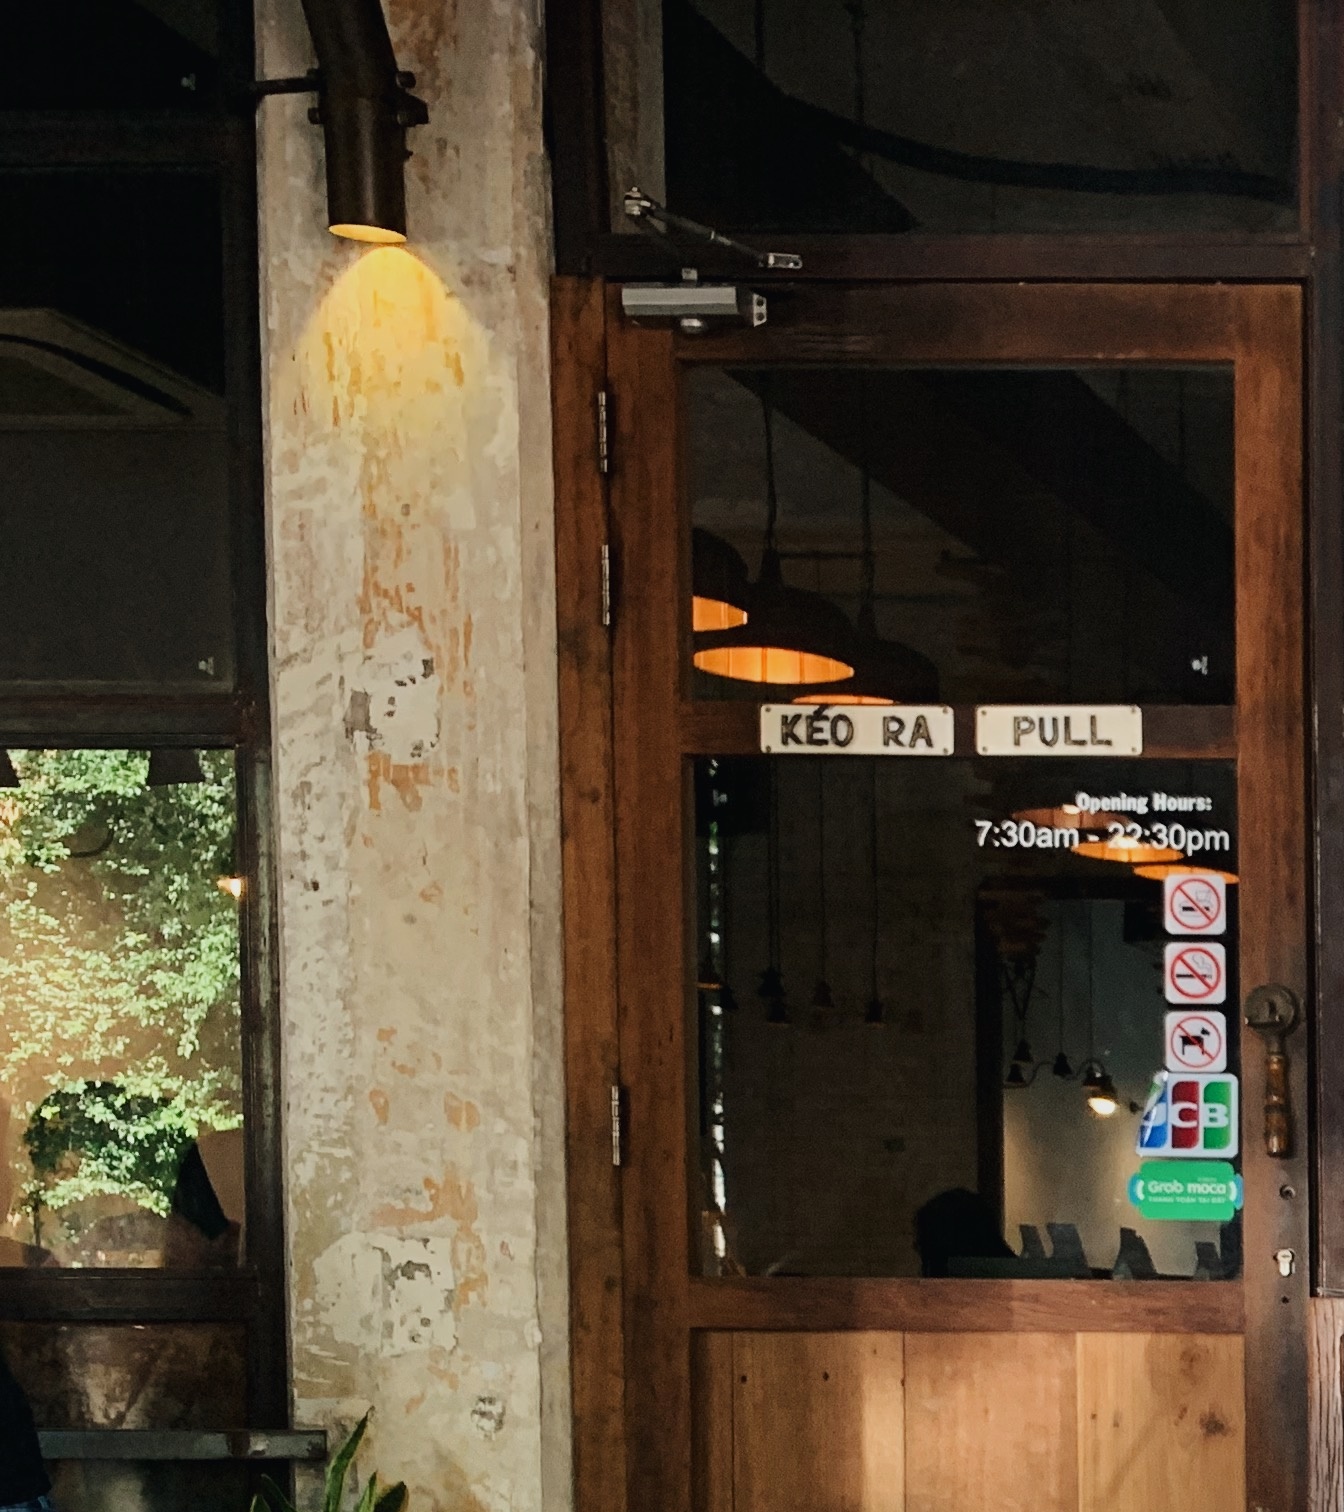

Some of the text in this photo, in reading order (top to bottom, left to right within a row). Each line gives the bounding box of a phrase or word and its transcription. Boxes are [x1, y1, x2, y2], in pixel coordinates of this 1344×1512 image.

[780, 704, 934, 748] KÉO RA
[1012, 715, 1113, 748] PULL
[1075, 791, 1212, 813] Opening Hours:
[975, 819, 1080, 849] 7:30am
[1107, 822, 1231, 857] 22:30pm
[1148, 1179, 1227, 1195] Grab moca
